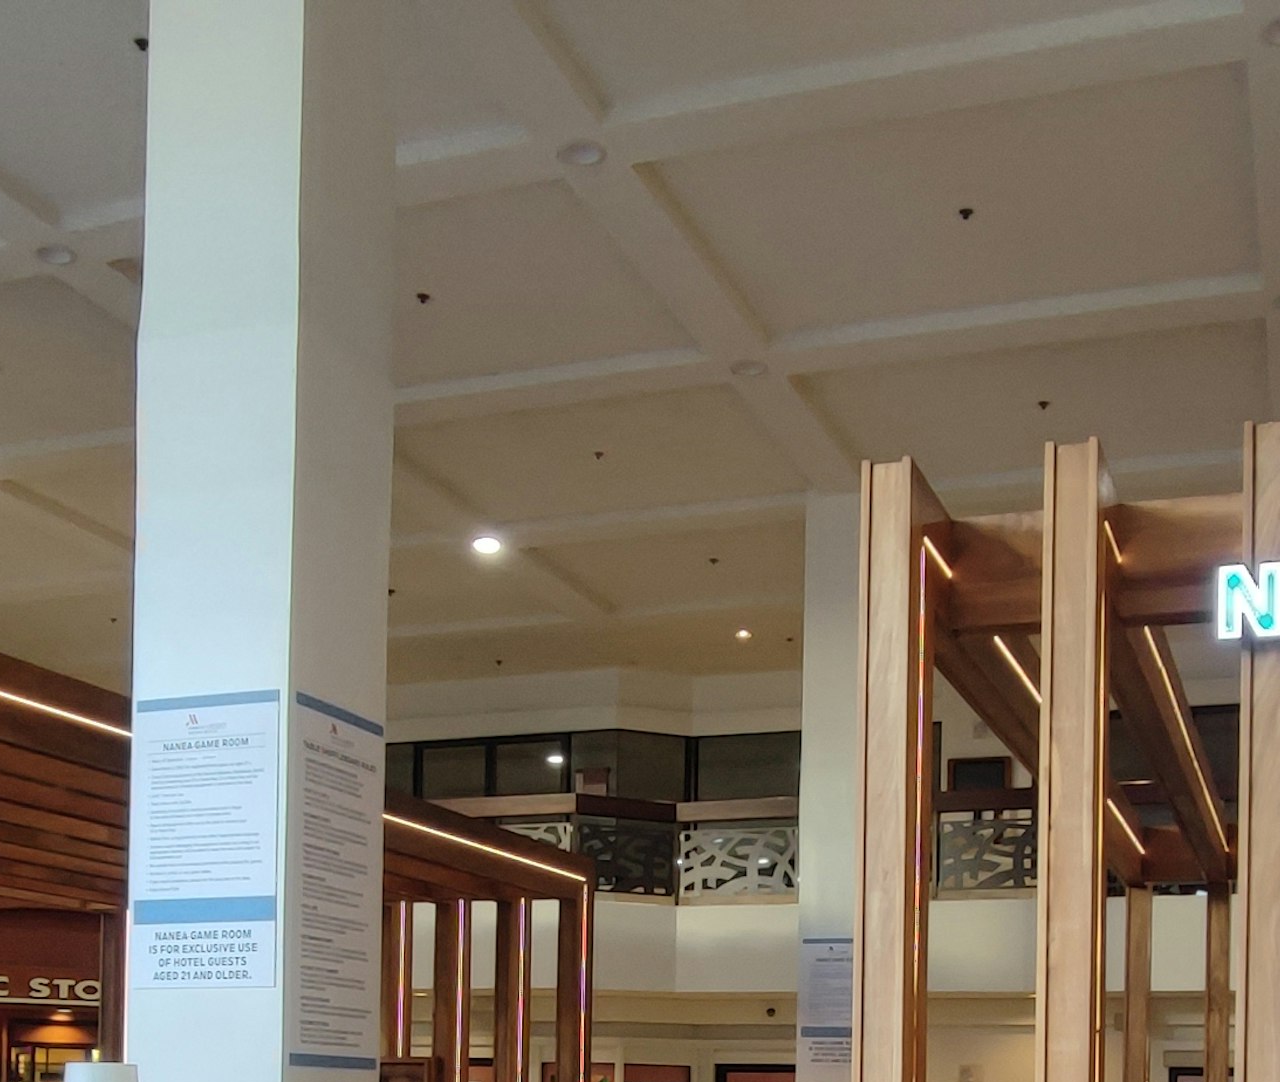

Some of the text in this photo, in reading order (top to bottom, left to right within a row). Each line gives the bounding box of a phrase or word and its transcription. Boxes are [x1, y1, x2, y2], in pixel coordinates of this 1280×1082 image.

[163, 737, 249, 752] NANEA GAME ROOM
[154, 928, 252, 941] NANEA GAME ROOM
[148, 942, 258, 955] IS FOR EXCLUSIVE USE
[158, 956, 247, 968] OF HOTEL GUESTS
[153, 969, 252, 981] AGED 21 AND OLDER.
